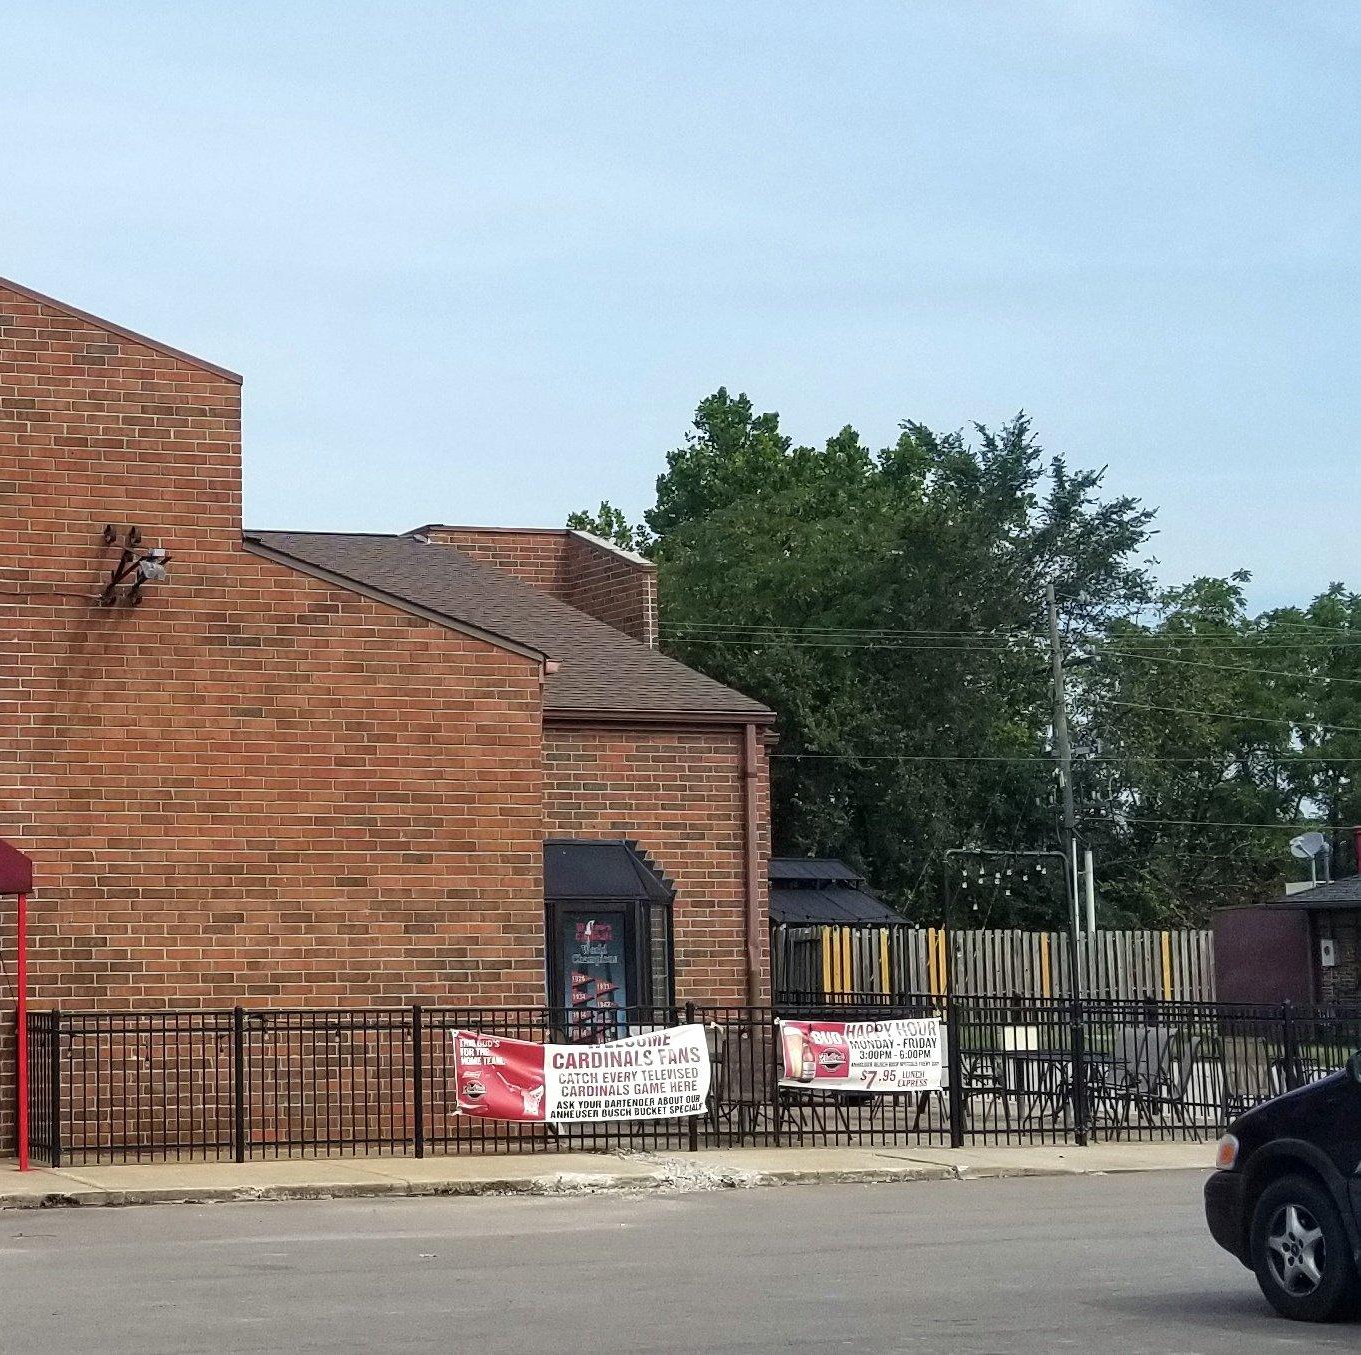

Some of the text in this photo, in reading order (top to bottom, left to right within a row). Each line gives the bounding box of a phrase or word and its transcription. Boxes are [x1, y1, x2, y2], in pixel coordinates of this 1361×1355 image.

[811, 1031, 843, 1045] BUD
[846, 1020, 937, 1040] HAPPY HOUR
[849, 1040, 894, 1049] MONDAY
[903, 1037, 937, 1048] FRIDAY
[552, 1046, 701, 1070] CARDINALS FANS
[859, 1050, 892, 1060] 3:00PM
[899, 1049, 931, 1059] 6:00PM
[558, 1067, 699, 1084] CATCH EVERY TELEVISED
[859, 1069, 897, 1089] $7.95
[897, 1079, 928, 1088] EXPRESS
[561, 1080, 698, 1098] CARDINALS GAME HERE
[556, 1094, 701, 1110] ASK YOUR BARTENDER ABOUT OUR
[550, 1109, 599, 1119] ANHEUSER
[601, 1107, 632, 1118] BUSCH
[634, 1106, 667, 1116] BUCKET
